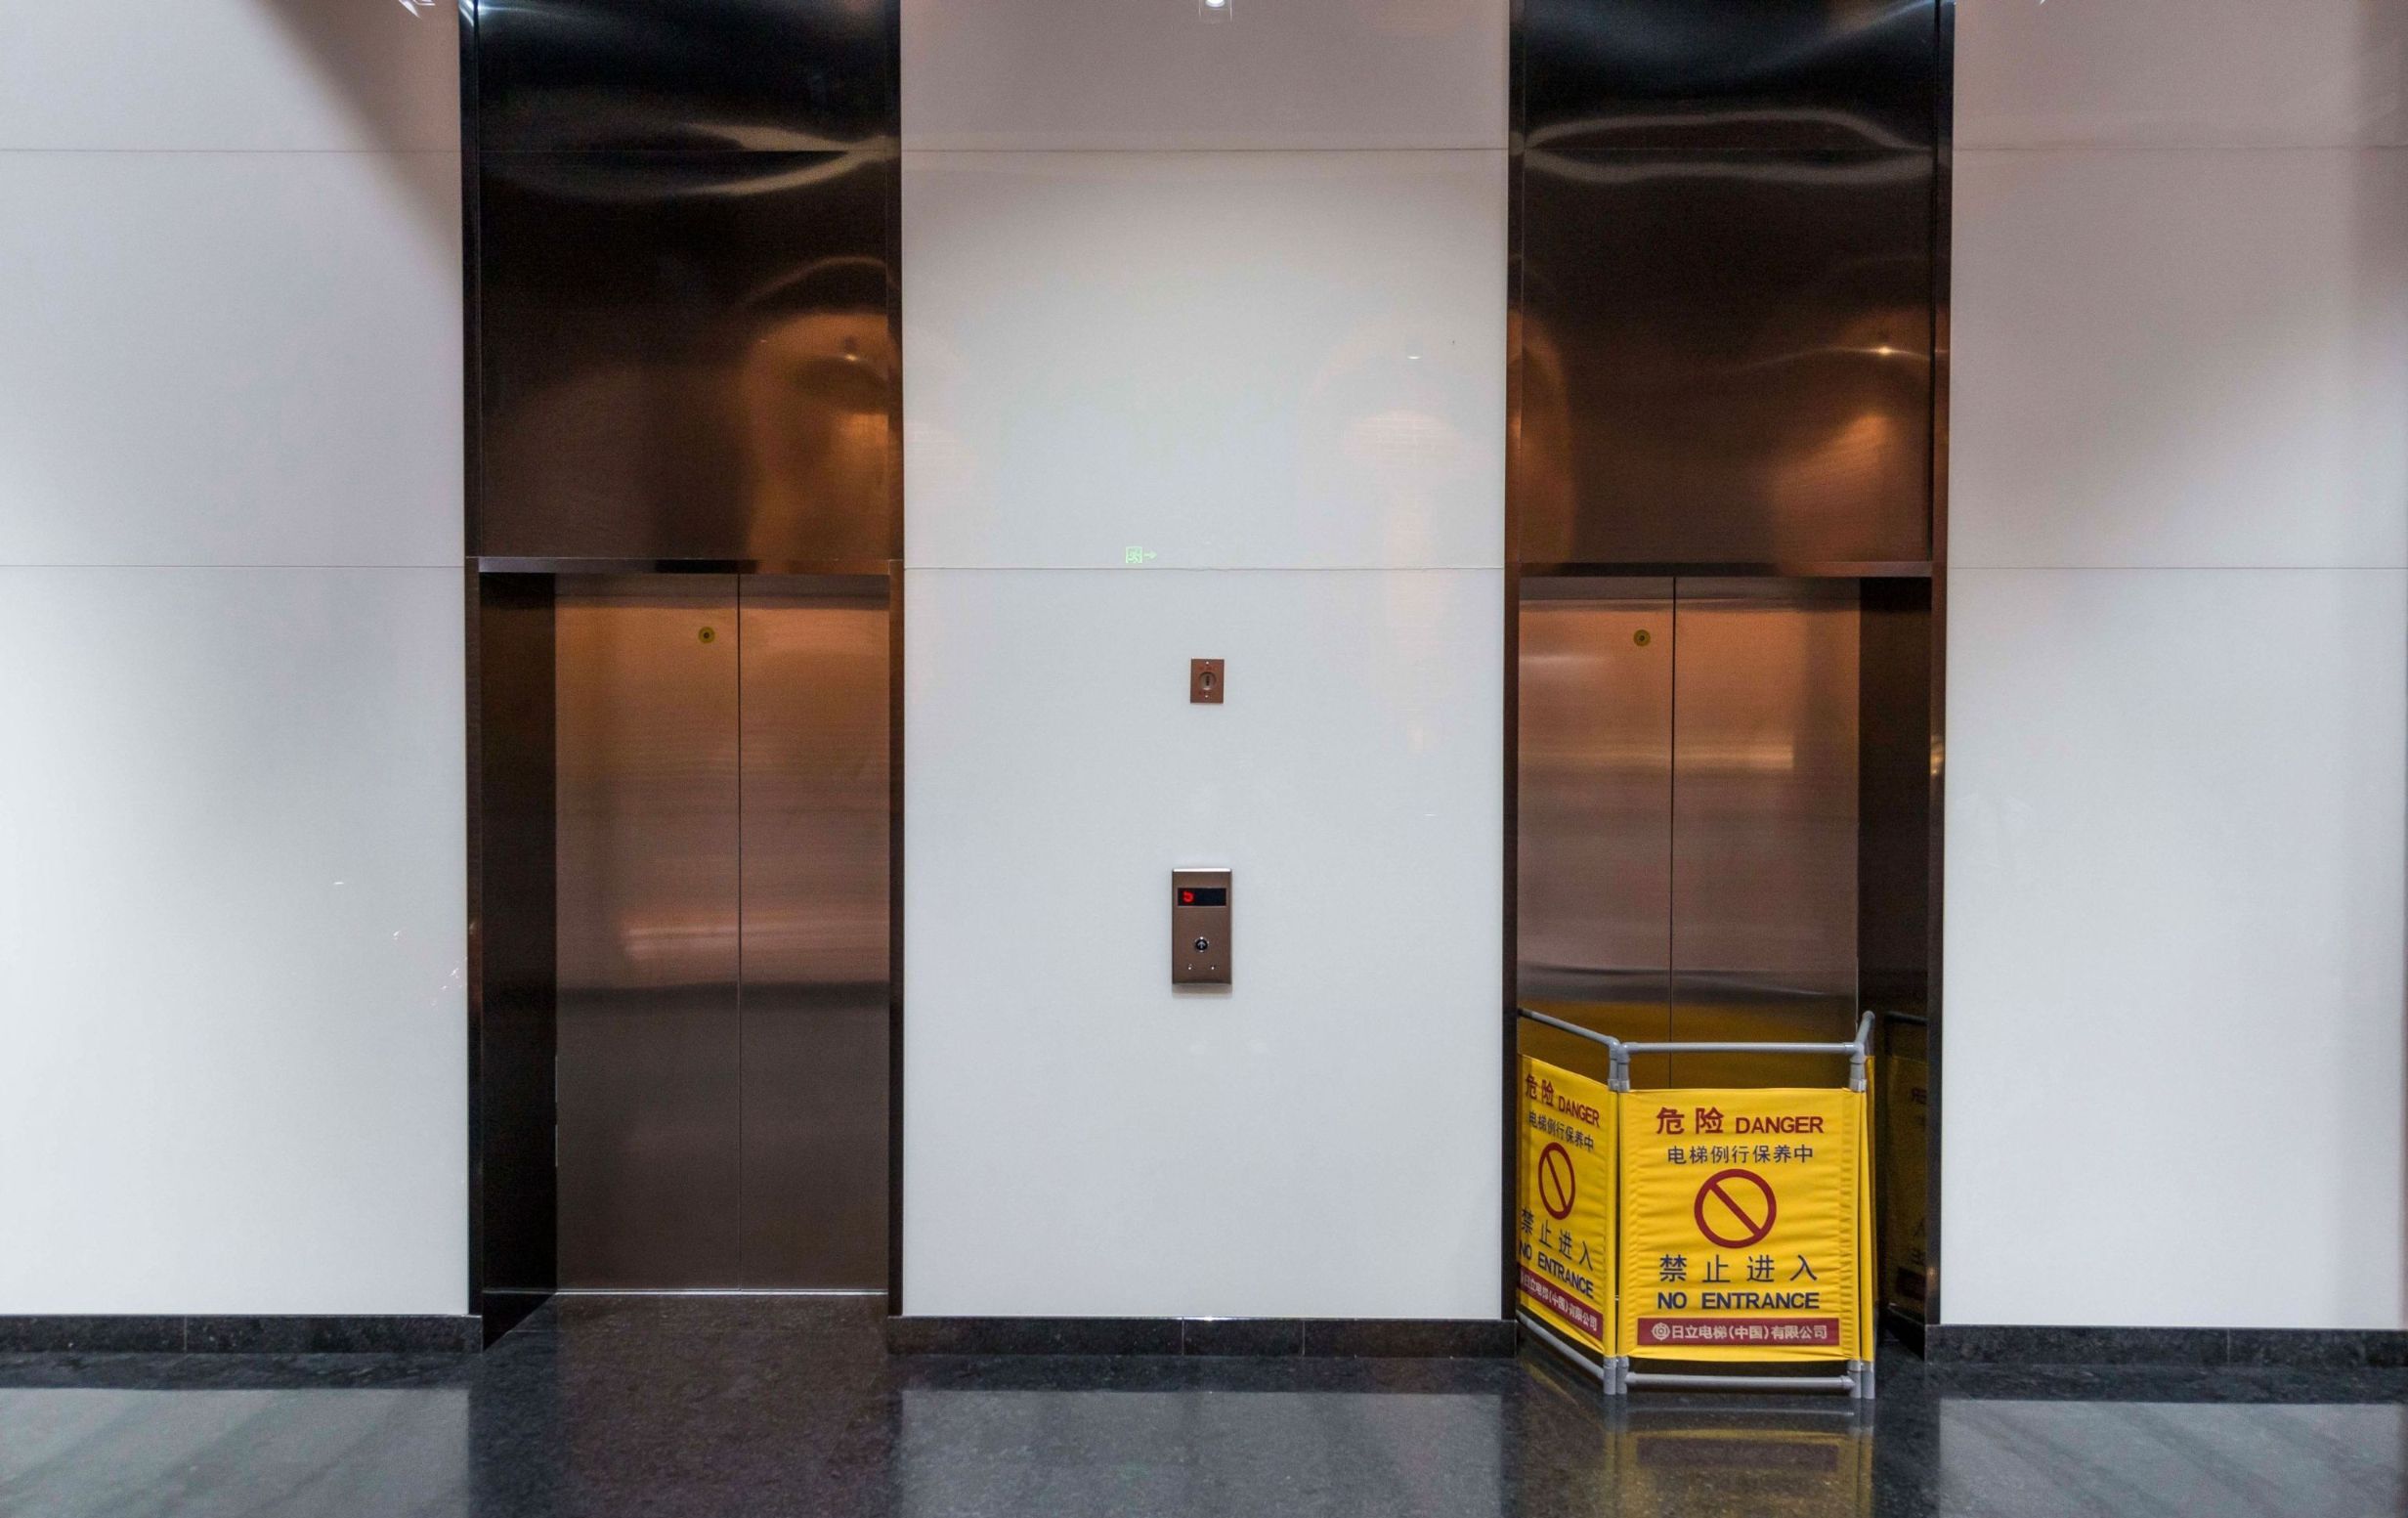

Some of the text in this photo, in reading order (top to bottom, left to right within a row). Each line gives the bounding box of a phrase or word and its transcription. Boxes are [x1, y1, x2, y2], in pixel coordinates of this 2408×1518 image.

[1526, 1073, 1600, 1128] 危险 DANGER
[1528, 1110, 1594, 1151] 电梯例行保养中
[1656, 1106, 1824, 1135] 危险 DANGER
[1667, 1144, 1814, 1165] 电梯例行保养中
[1519, 1239, 1594, 1300] NO ENTRANCE
[1659, 1254, 1818, 1283] 禁止进入
[1657, 1292, 1820, 1310] NO ENTRANCE
[1671, 1324, 1828, 1340] 日立电梯(中国)有限公司
